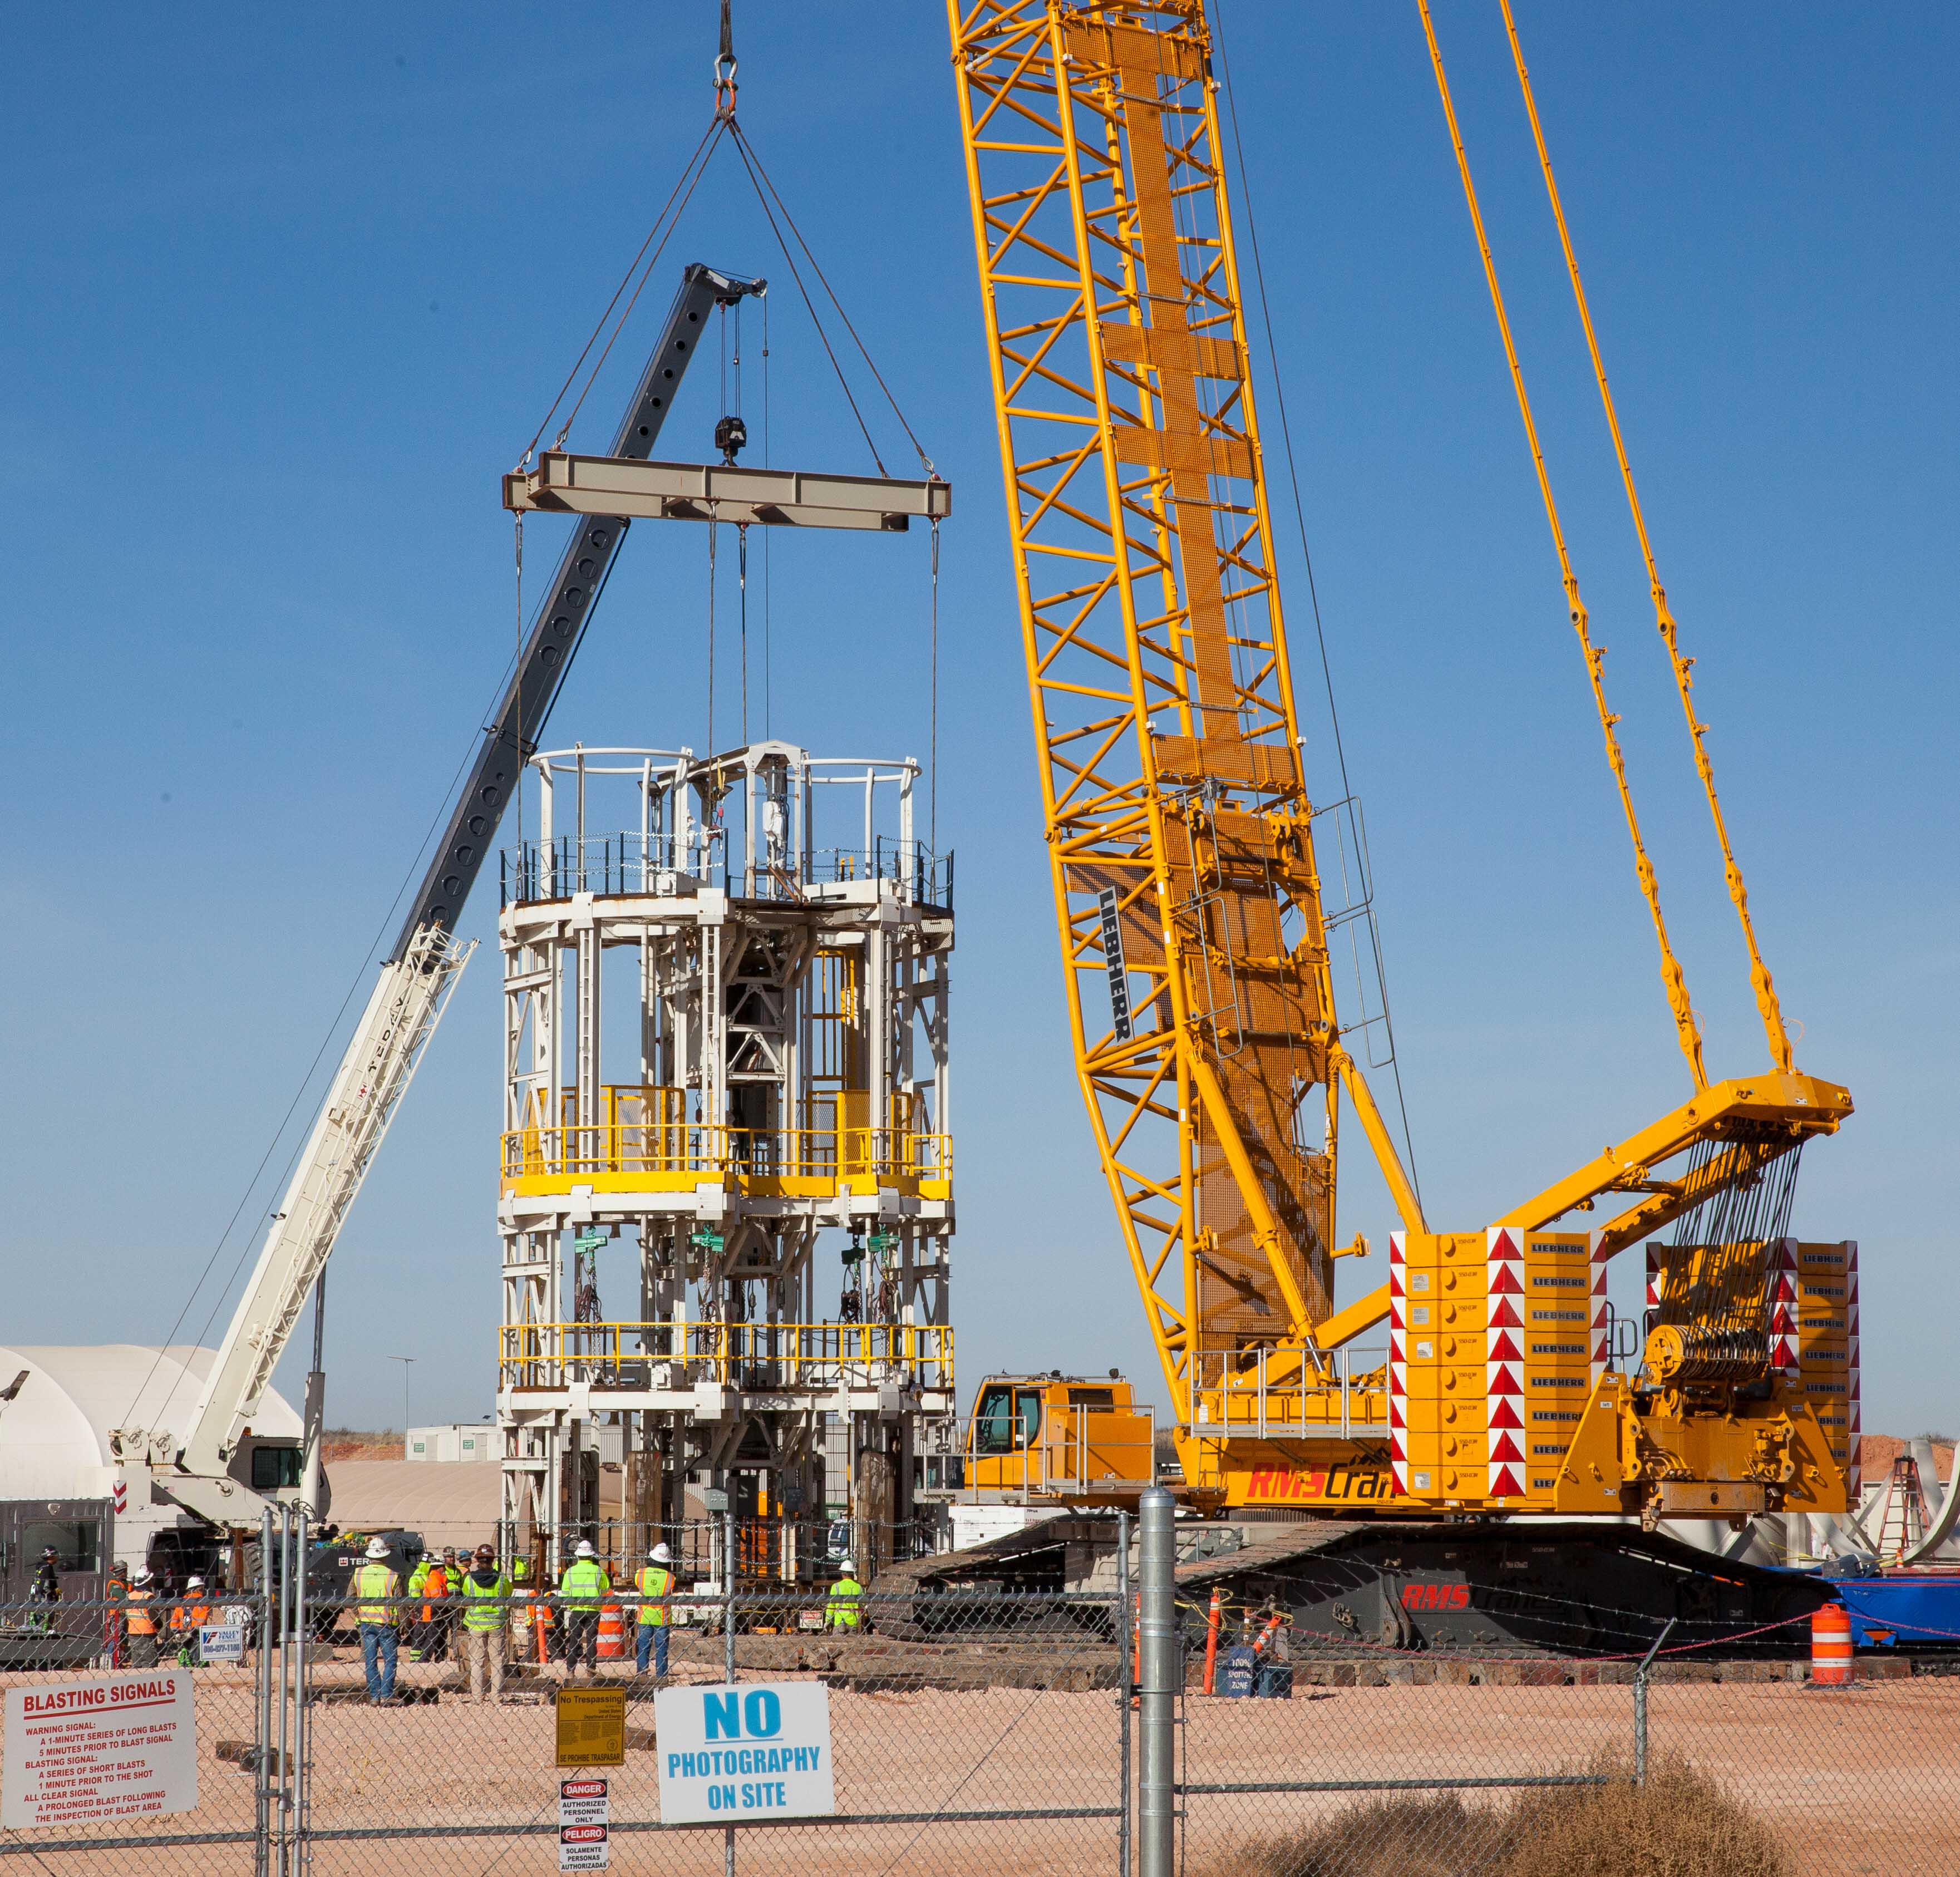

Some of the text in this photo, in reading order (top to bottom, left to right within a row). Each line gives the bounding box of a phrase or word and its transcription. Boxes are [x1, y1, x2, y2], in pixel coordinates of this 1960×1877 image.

[1099, 890, 1131, 1042] LIEBHERR
[1532, 1245, 1584, 1253] LIEBHERR
[1805, 1287, 1844, 1295] LIEBHERR
[1532, 1344, 1585, 1353] LIEBHERR
[1532, 1378, 1585, 1386] LIEBHERR
[1401, 1585, 1470, 1609] RMS
[1232, 1659, 1251, 1667] 100%
[24, 1679, 175, 1712] BLASTING SIGNALS
[574, 1695, 622, 1704] Trespassing
[703, 1689, 781, 1740] NO
[26, 1722, 96, 1736] WARNING SIGNAL:
[48, 1735, 85, 1745] 1-MINUTE
[87, 1731, 114, 1741] SERIES
[127, 1726, 147, 1736] LONG
[150, 1722, 176, 1732] BLASTS
[46, 1746, 81, 1756] MINUTES
[83, 1742, 106, 1752] PRIOR
[121, 1738, 144, 1747] BLAST
[146, 1734, 173, 1744] SIGNAL
[25, 1756, 98, 1769] BLASTING SIGNAL:
[47, 1768, 74, 1778] SERIES
[89, 1763, 115, 1773] SHORT
[117, 1760, 145, 1770] BLASTS
[668, 1746, 820, 1778] PHOTOGRAPHY
[46, 1780, 76, 1789] MINUTE
[78, 1776, 102, 1785] PRIOR
[116, 1773, 131, 1781] THE
[134, 1770, 153, 1779] SHOT
[24, 1788, 98, 1802] ALL CLEAR SIGNAL
[567, 1785, 601, 1794] DANGER
[708, 1782, 786, 1810] ON SITE
[46, 1799, 93, 1811] PROLONGED
[96, 1796, 121, 1806] BLAST
[122, 1790, 166, 1802] FOLLOWING
[35, 1815, 51, 1823] THE
[53, 1810, 101, 1821] INSPECTION
[116, 1805, 140, 1815] BLAST
[142, 1802, 162, 1811] AREA
[565, 1829, 602, 1839] PELIGRO
